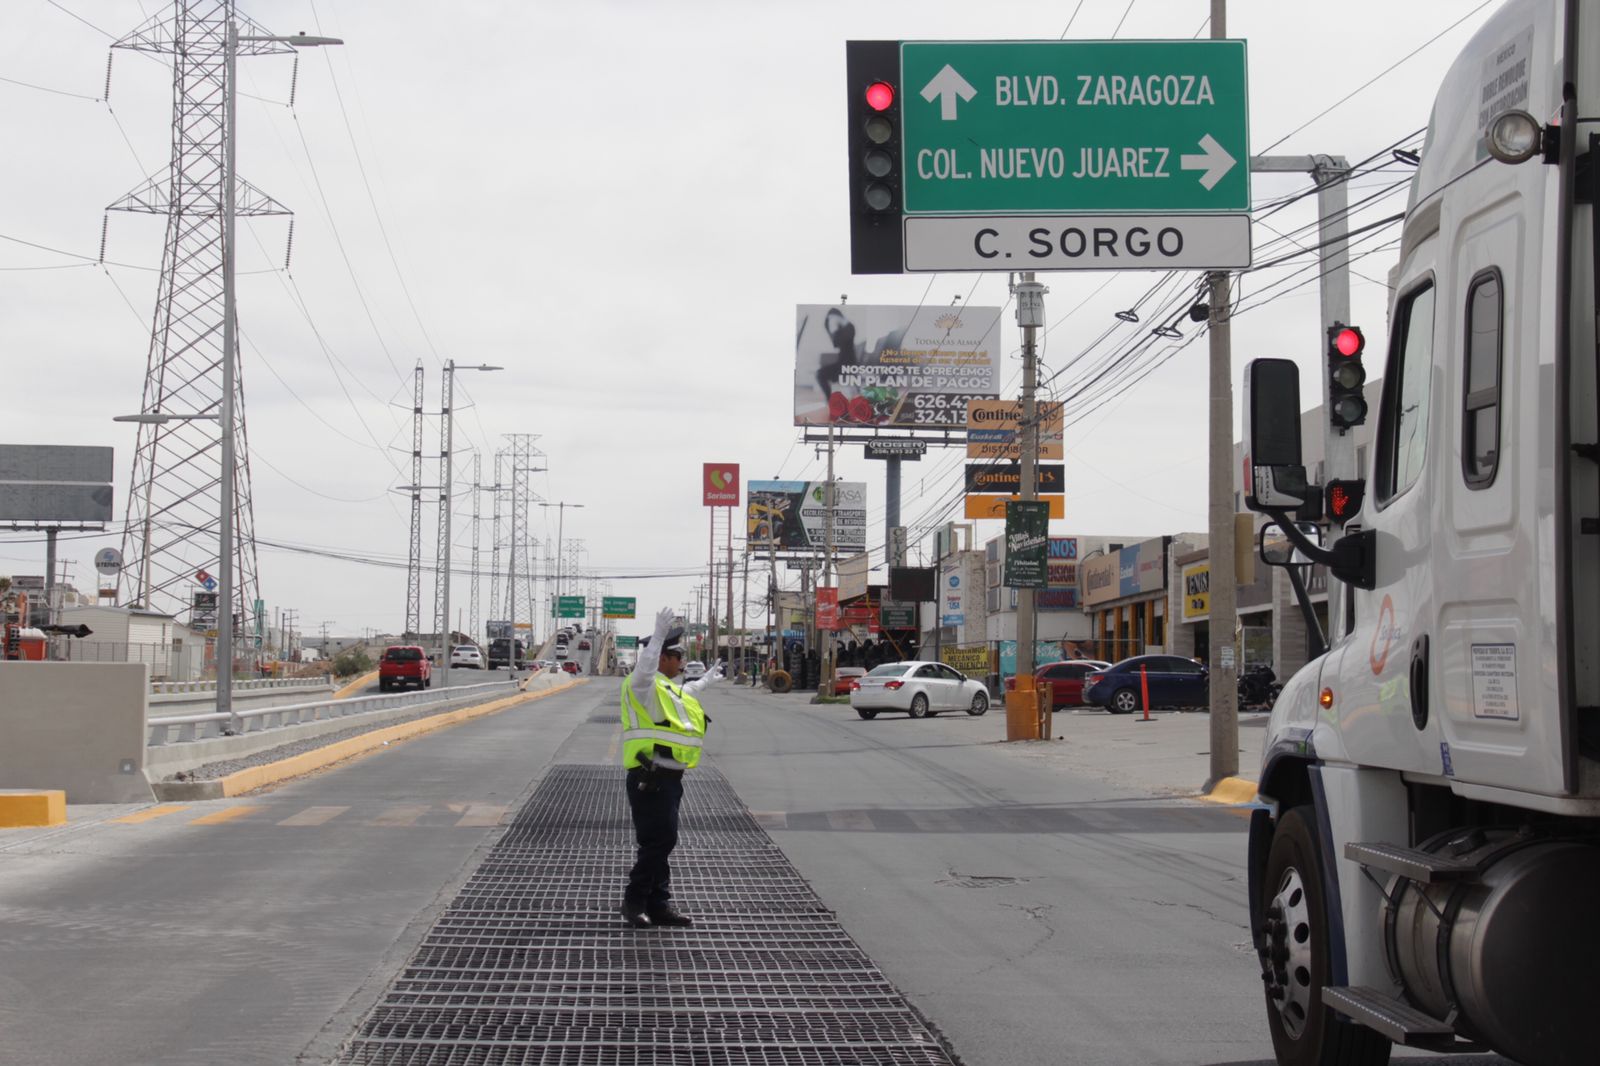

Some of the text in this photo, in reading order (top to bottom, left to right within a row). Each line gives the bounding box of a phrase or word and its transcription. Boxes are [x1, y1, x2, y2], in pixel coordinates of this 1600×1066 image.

[995, 74, 1215, 105] BLVD. ZARAGOZA
[917, 147, 1170, 179] COL. NUEVO JUAREZ
[974, 227, 1184, 258] C. SORGO
[879, 356, 911, 364] funeral
[841, 364, 993, 376] NOSOTROS TE OFRECEMOS
[838, 374, 991, 389] UN PLAN DE PAGOS
[706, 491, 736, 500] Soriana
